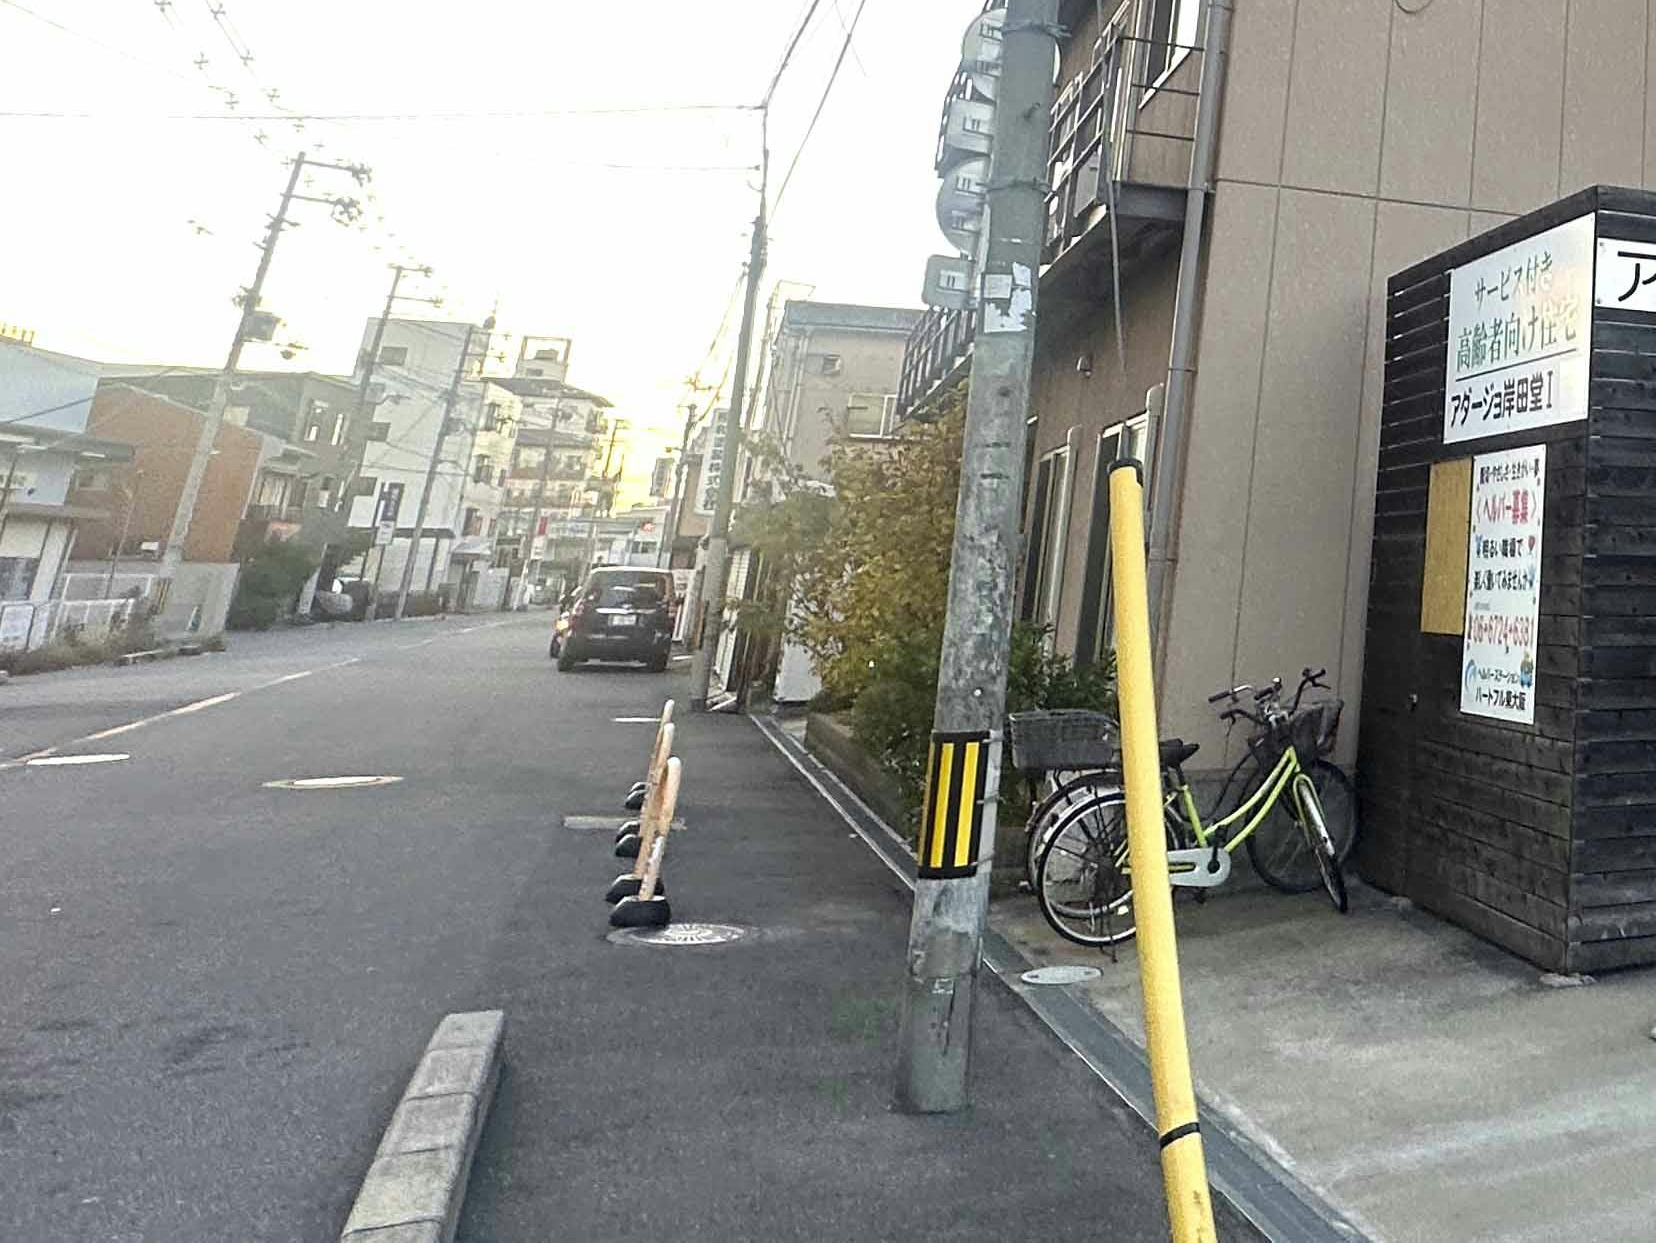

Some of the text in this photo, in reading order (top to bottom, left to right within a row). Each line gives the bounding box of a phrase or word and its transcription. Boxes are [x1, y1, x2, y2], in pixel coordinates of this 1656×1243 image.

[1475, 252, 1553, 310] サービス付き
[1456, 298, 1577, 372] 高齢者向け住宅
